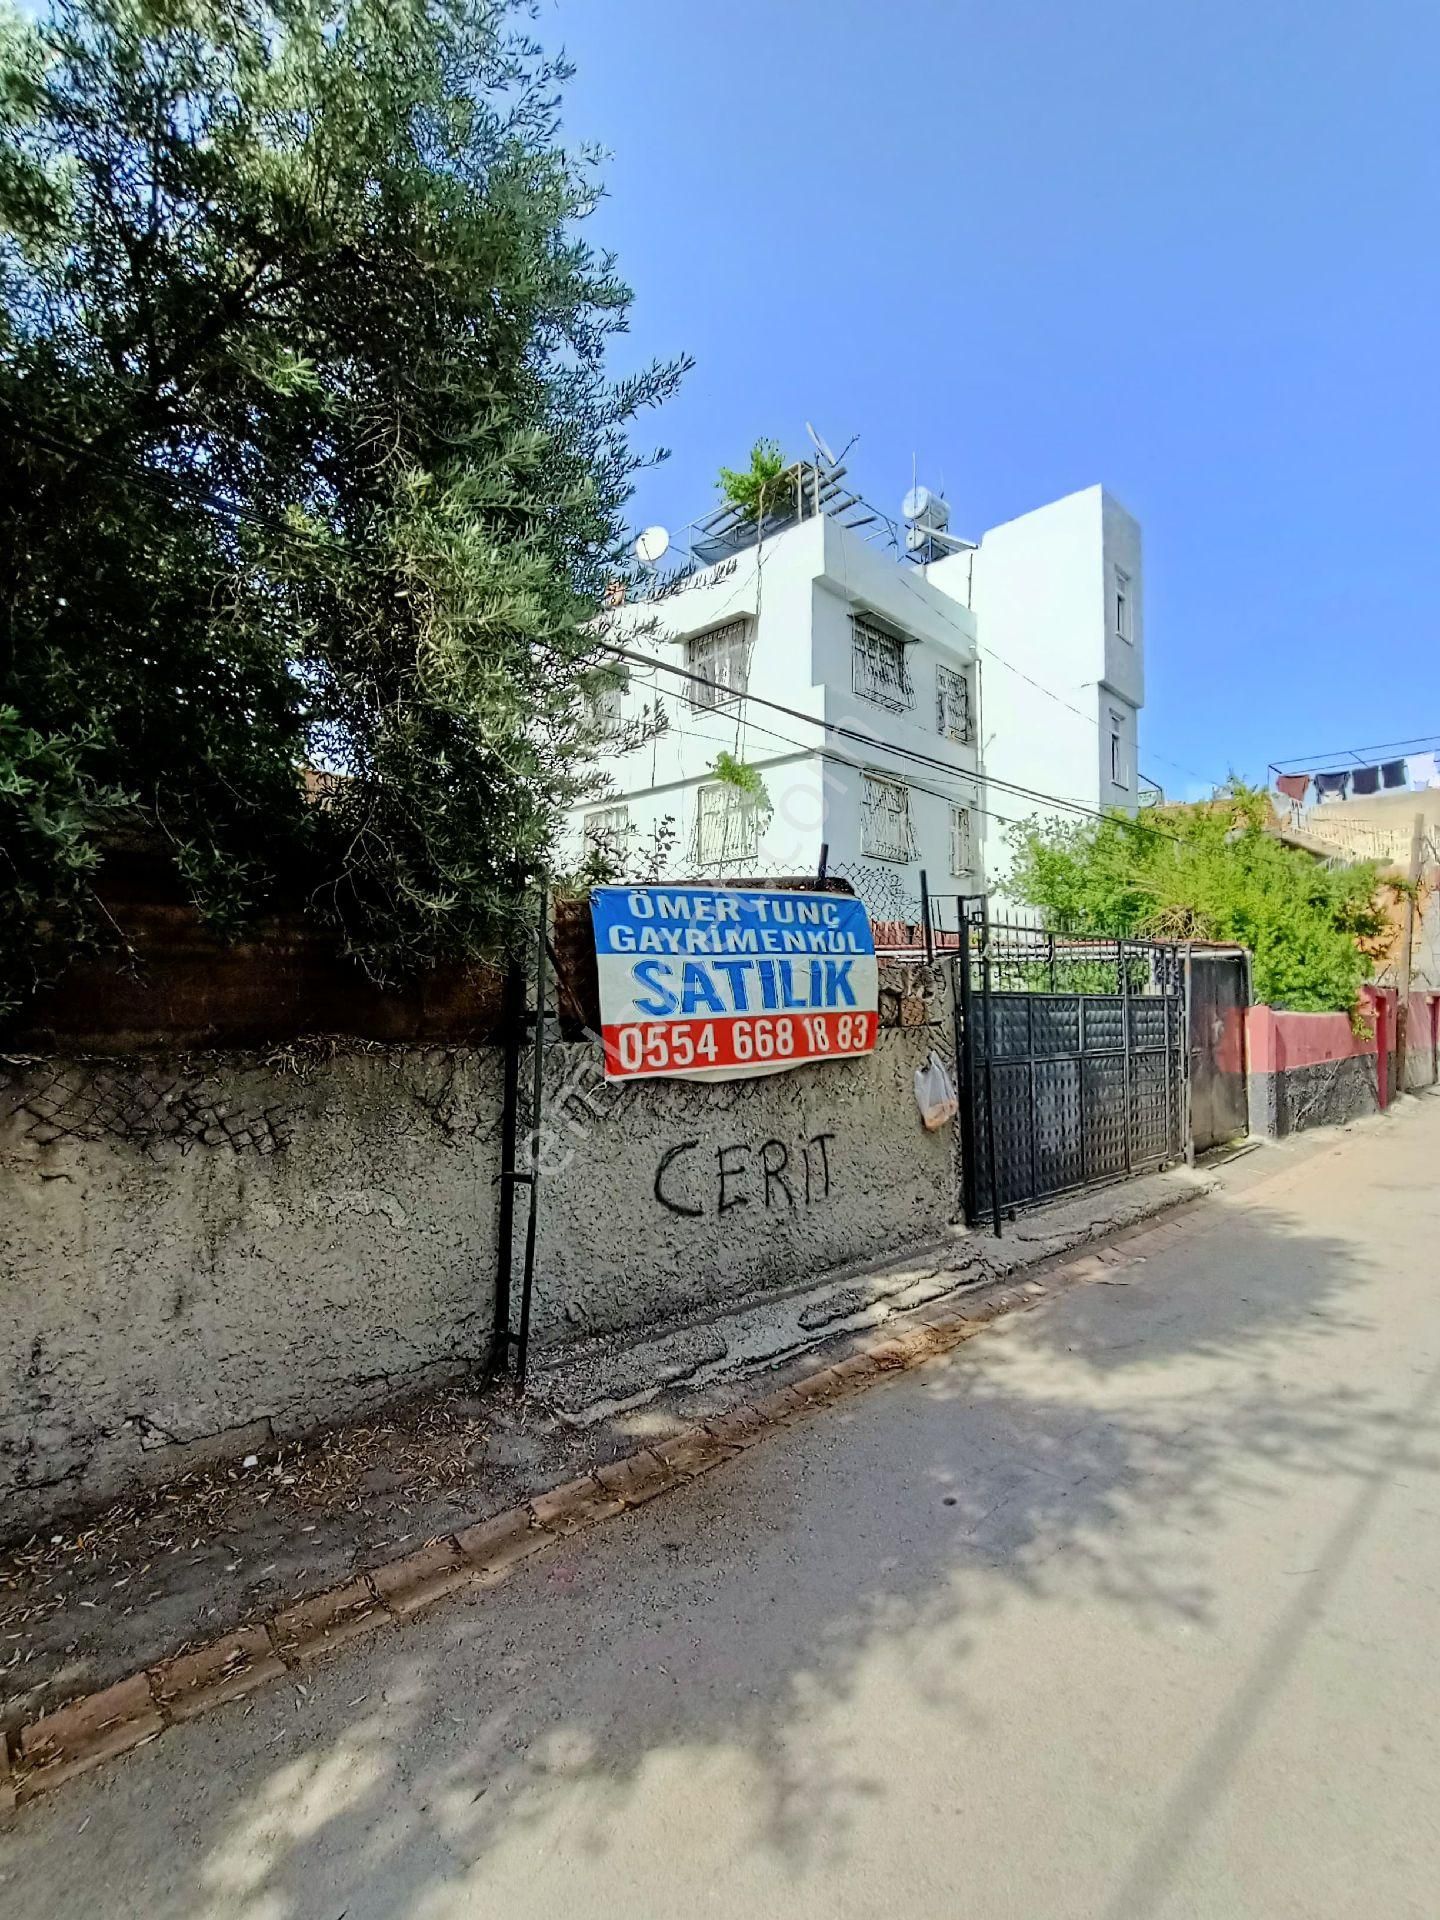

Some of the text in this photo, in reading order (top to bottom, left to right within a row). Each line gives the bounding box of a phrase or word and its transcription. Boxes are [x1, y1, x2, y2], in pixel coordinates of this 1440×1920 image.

[628, 890, 840, 929] ÖMER TUNÇ
[632, 959, 858, 1016] SATILIK
[618, 1014, 869, 1071] 0554 668 18 83
